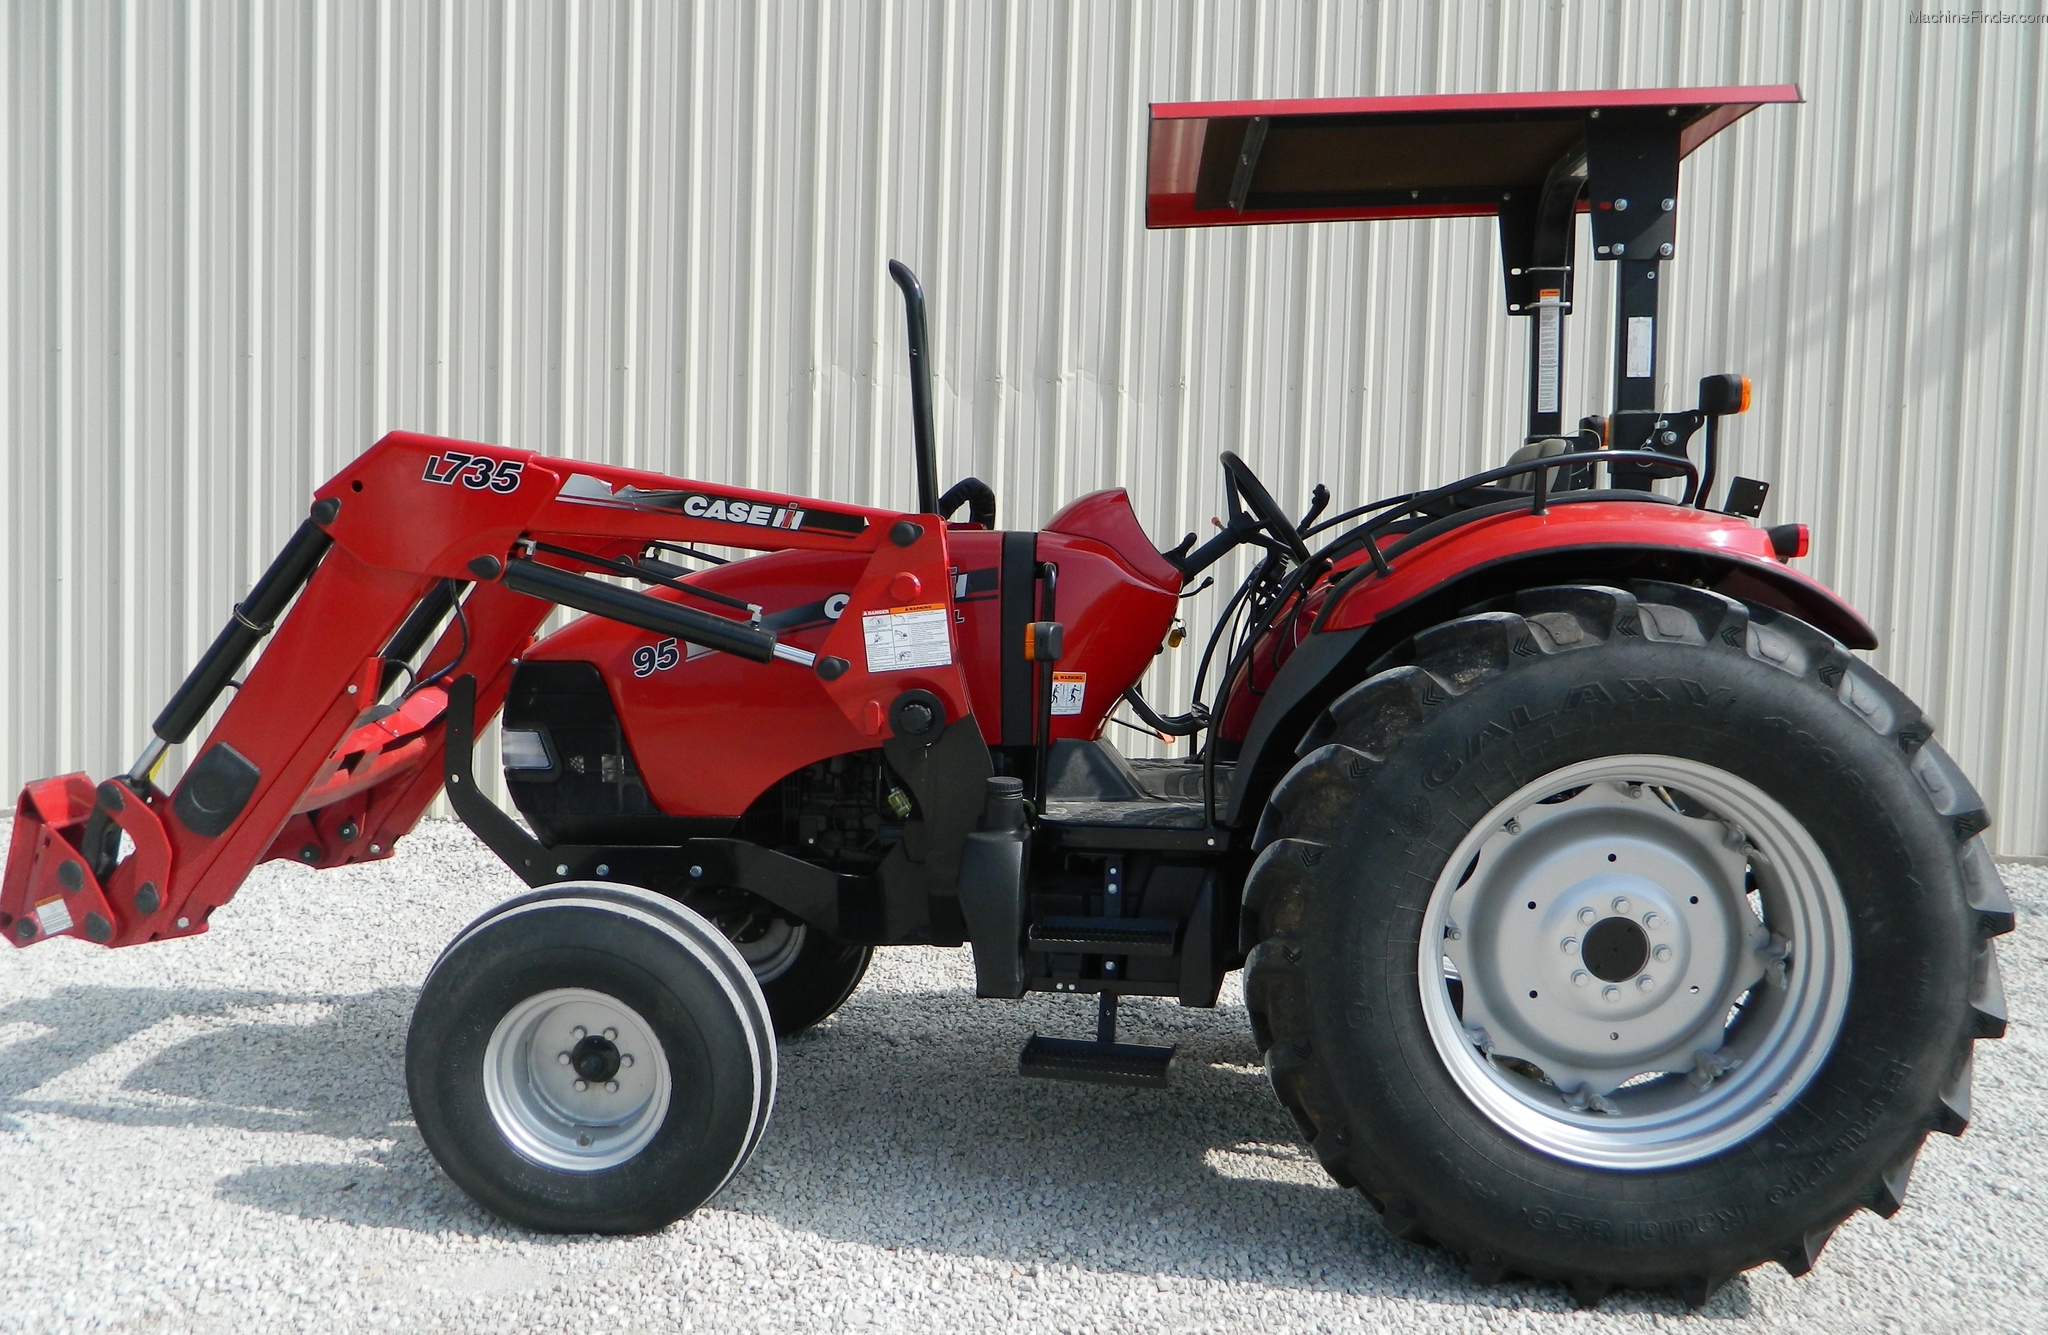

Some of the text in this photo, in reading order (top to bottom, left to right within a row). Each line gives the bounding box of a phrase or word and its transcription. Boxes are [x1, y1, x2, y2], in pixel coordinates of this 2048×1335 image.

[422, 451, 523, 494] L735
[683, 495, 772, 526] CASE
[632, 637, 680, 678] 95
[1421, 677, 1732, 791] GALAXY
[1624, 1202, 1748, 1246] Radial
